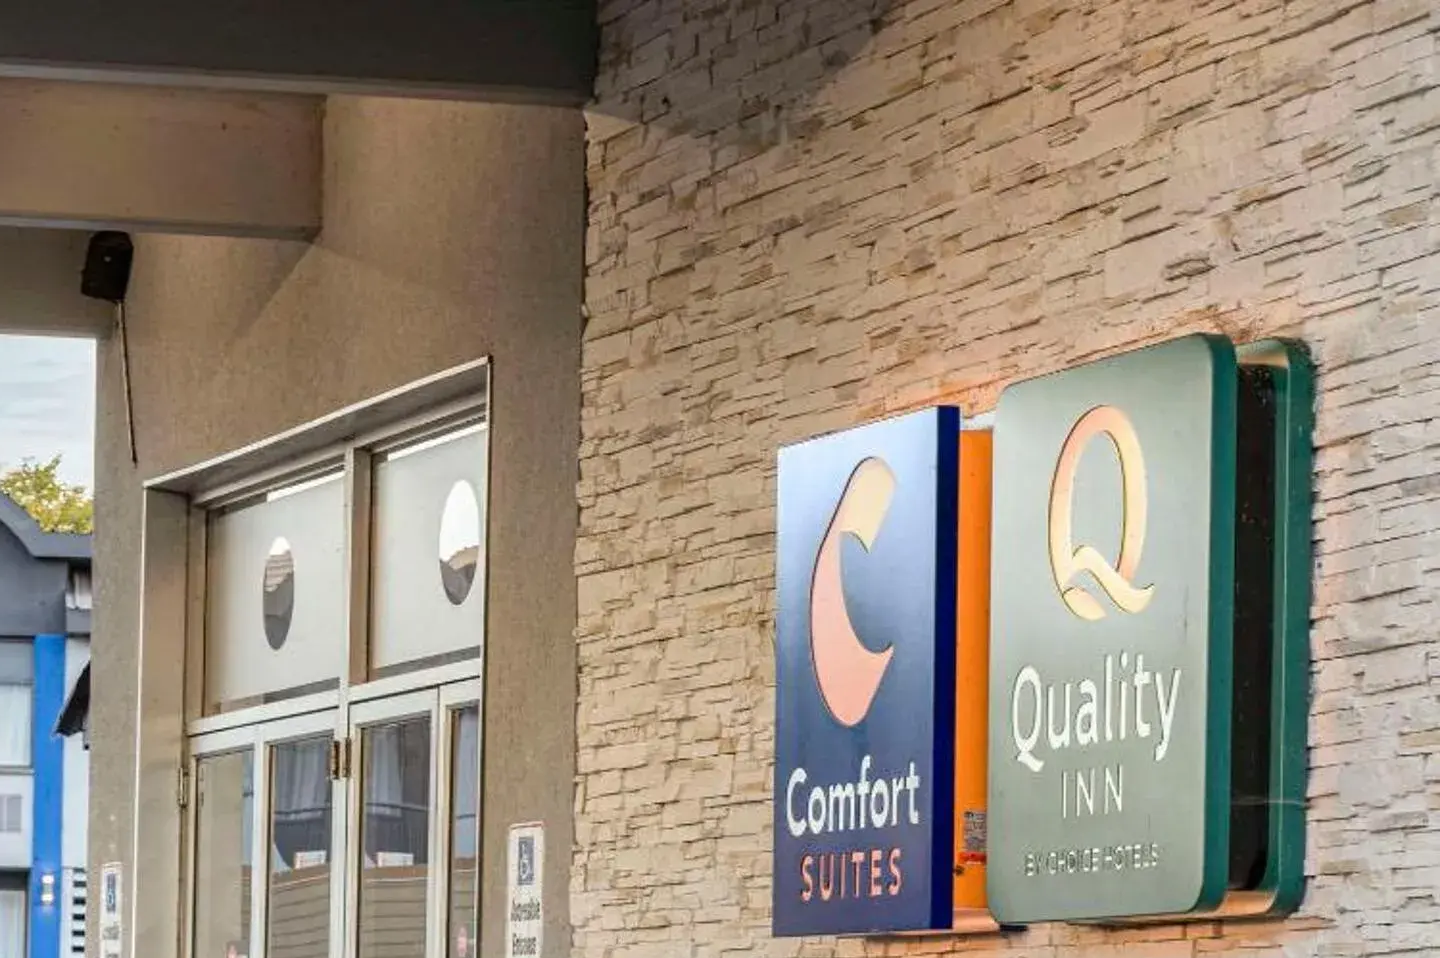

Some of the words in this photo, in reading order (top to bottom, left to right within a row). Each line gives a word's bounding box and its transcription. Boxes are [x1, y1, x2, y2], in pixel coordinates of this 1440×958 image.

[1012, 652, 1182, 773] Quality
[786, 755, 921, 838] Comfort
[1062, 764, 1123, 819] INN
[800, 847, 903, 902] SUITES
[1045, 848, 1101, 875] CHOICE
[1103, 843, 1160, 871] HOTELS
